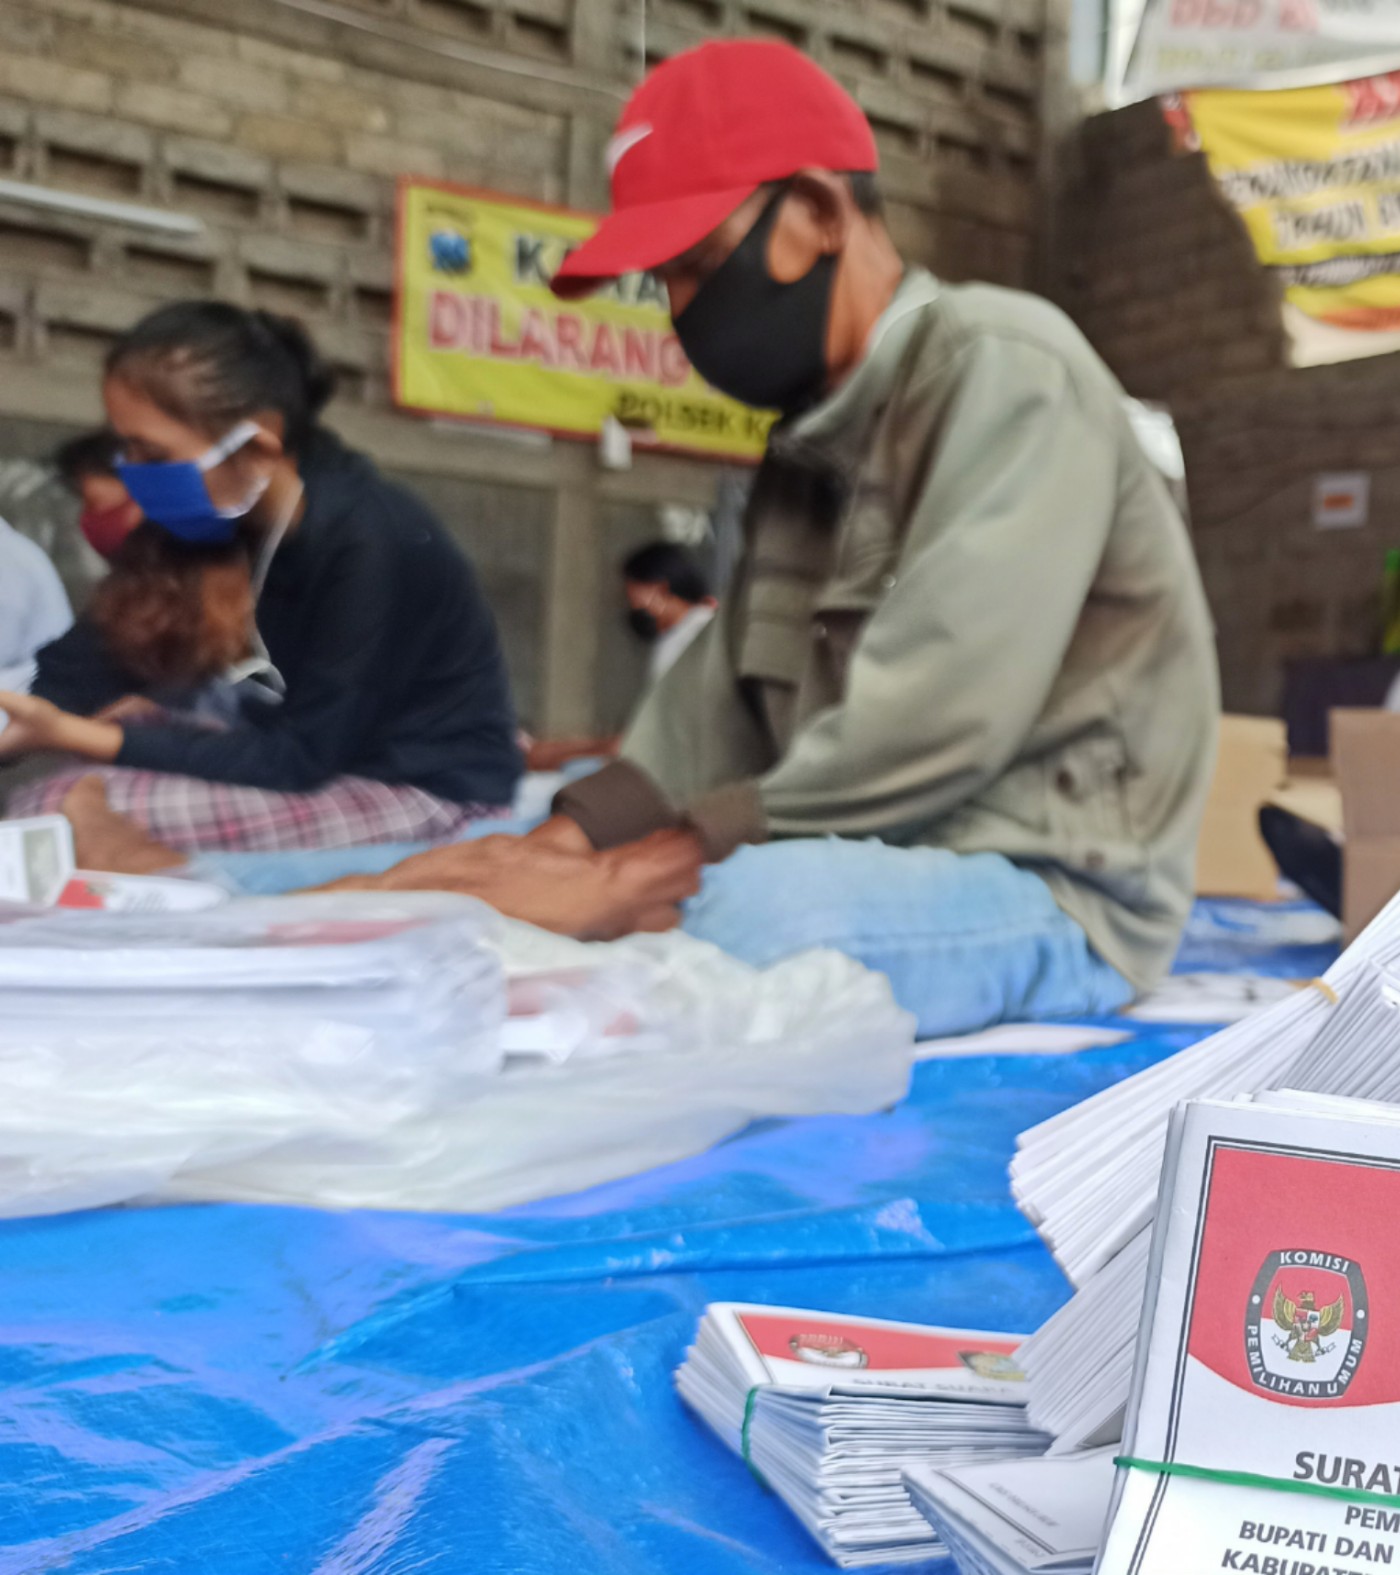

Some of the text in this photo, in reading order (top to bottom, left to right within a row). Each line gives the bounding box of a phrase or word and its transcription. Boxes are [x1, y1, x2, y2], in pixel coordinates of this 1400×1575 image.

[430, 290, 692, 388] DILARANG
[1280, 1252, 1349, 1273] KOMISI
[1248, 1325, 1363, 1395] PEMILIHAN UMUM
[1239, 1520, 1327, 1553] BUPATI
[1334, 1536, 1394, 1564] DAN
